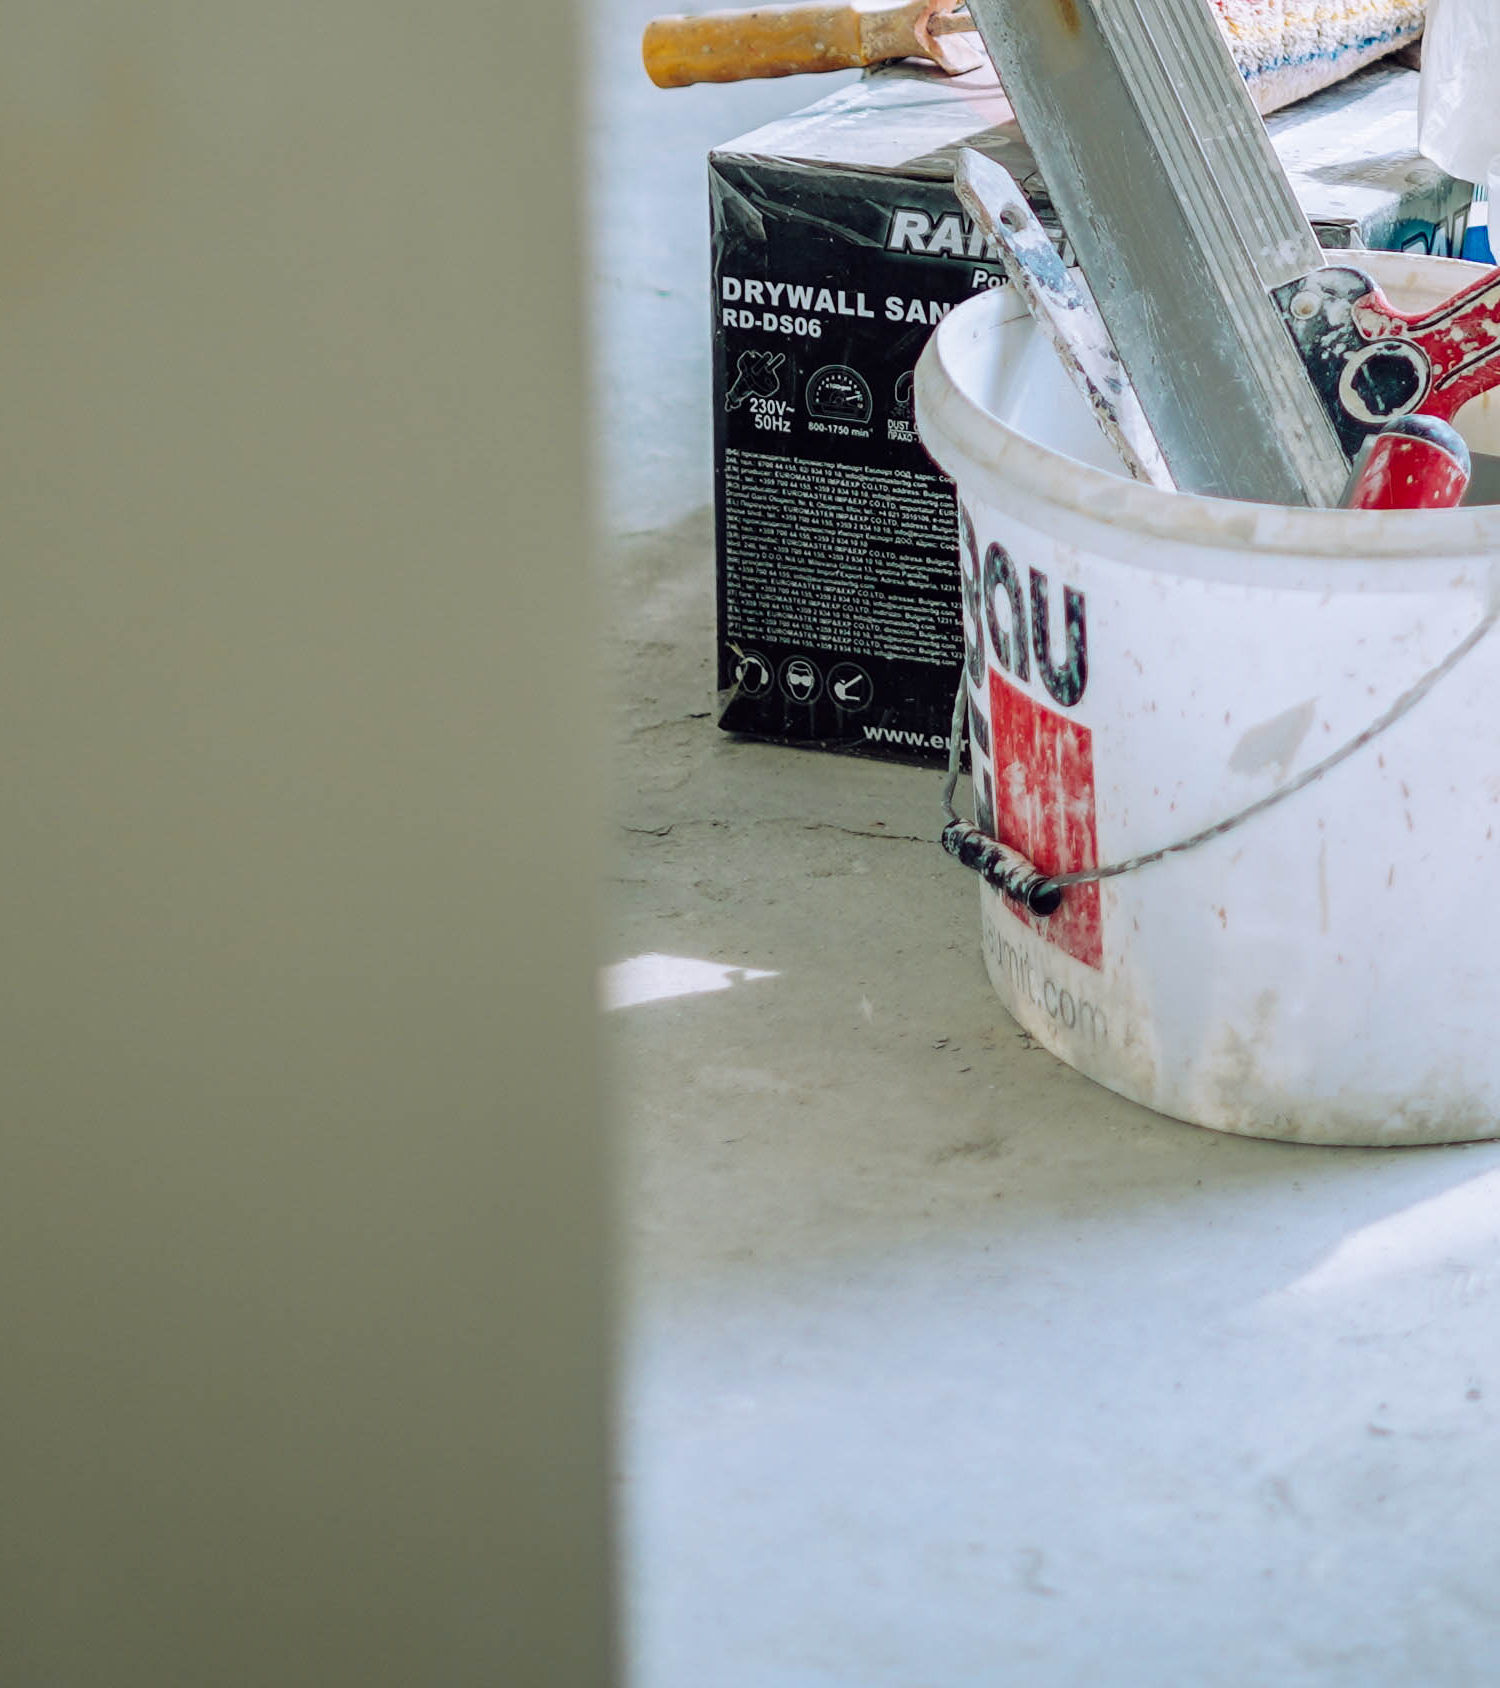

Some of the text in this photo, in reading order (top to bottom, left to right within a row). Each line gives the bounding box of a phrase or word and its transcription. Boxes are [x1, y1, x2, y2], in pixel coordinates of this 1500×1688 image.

[723, 276, 961, 325] DRYWALL SAN
[723, 308, 821, 338] RD-DS06
[750, 398, 795, 415] 230V~
[755, 414, 791, 433] 50Hz
[808, 421, 849, 435] 800-1750
[887, 419, 910, 430] DUST
